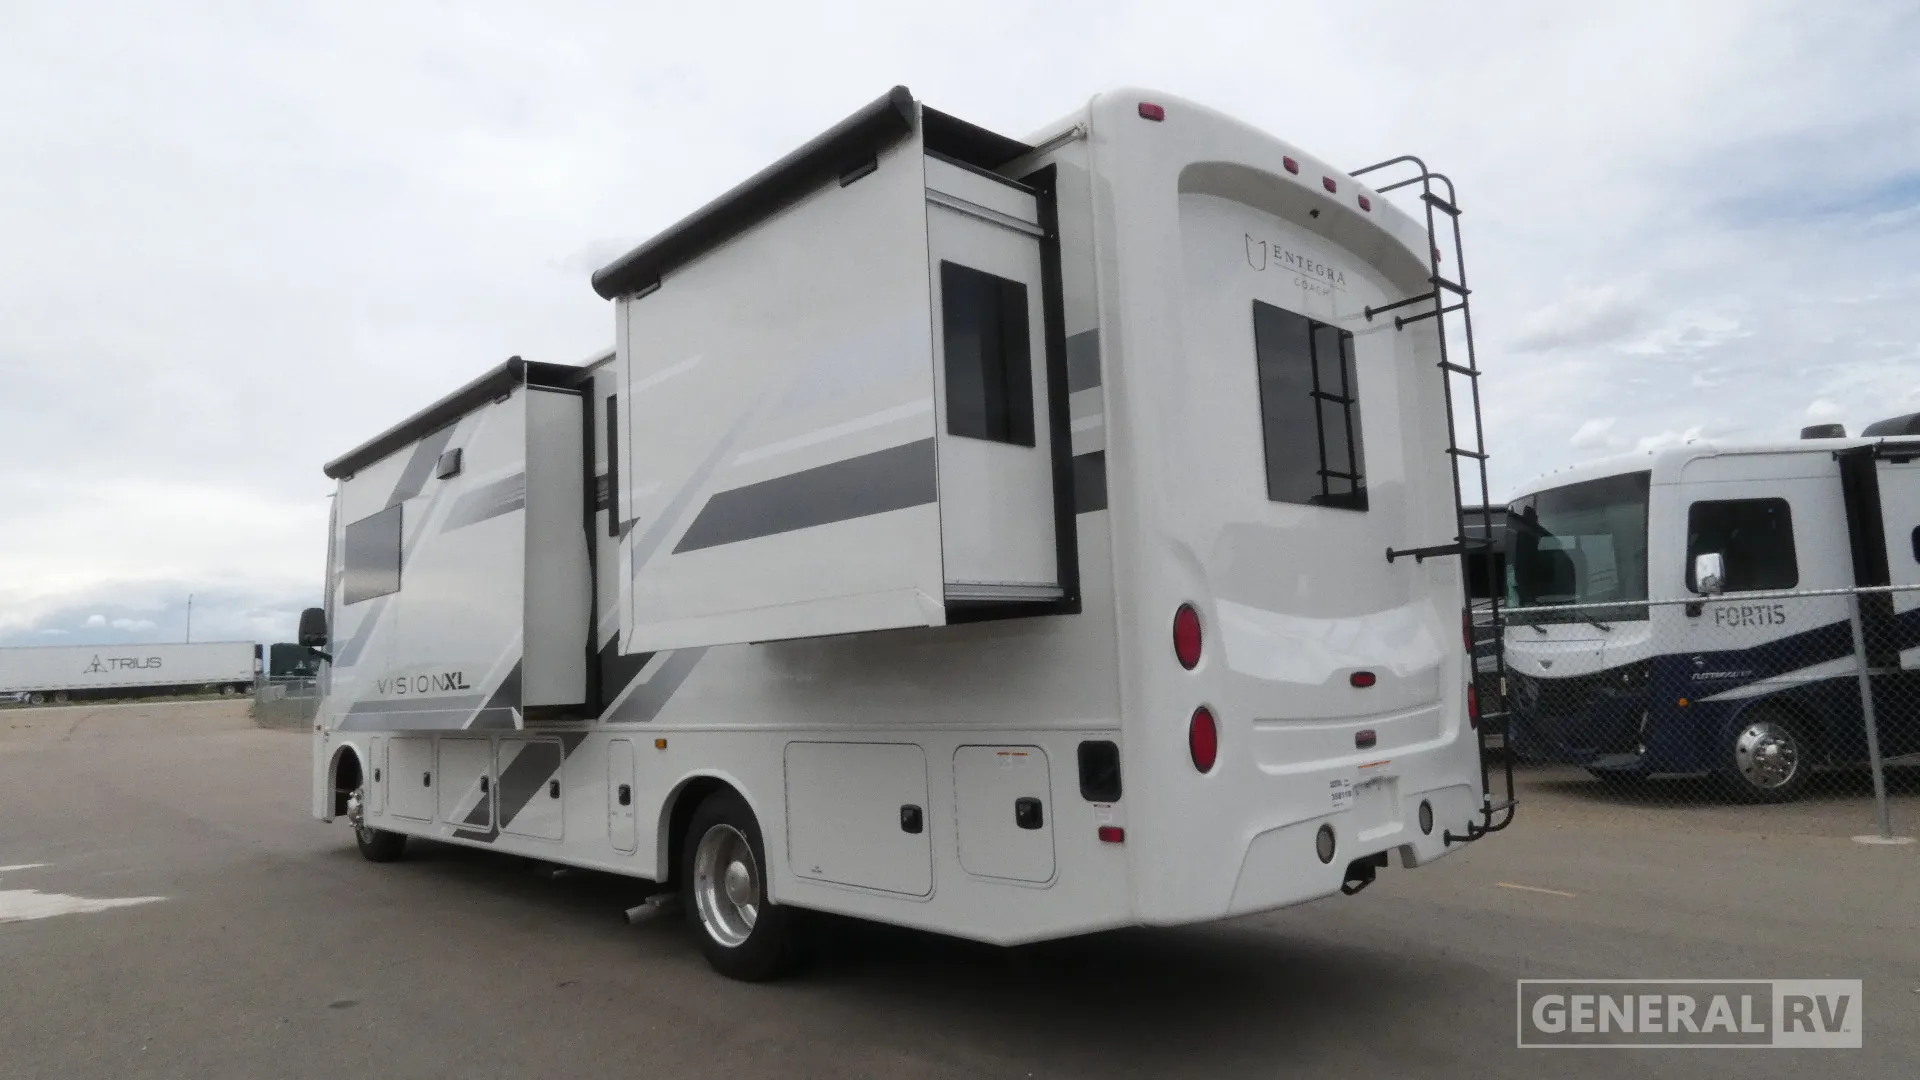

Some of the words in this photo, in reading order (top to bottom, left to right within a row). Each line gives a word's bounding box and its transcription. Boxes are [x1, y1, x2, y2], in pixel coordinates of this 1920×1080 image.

[1273, 245, 1346, 285] ENTEGRA
[1294, 278, 1330, 296] COACH
[1715, 604, 1786, 627] FORTIS
[108, 657, 162, 669] TRIUS
